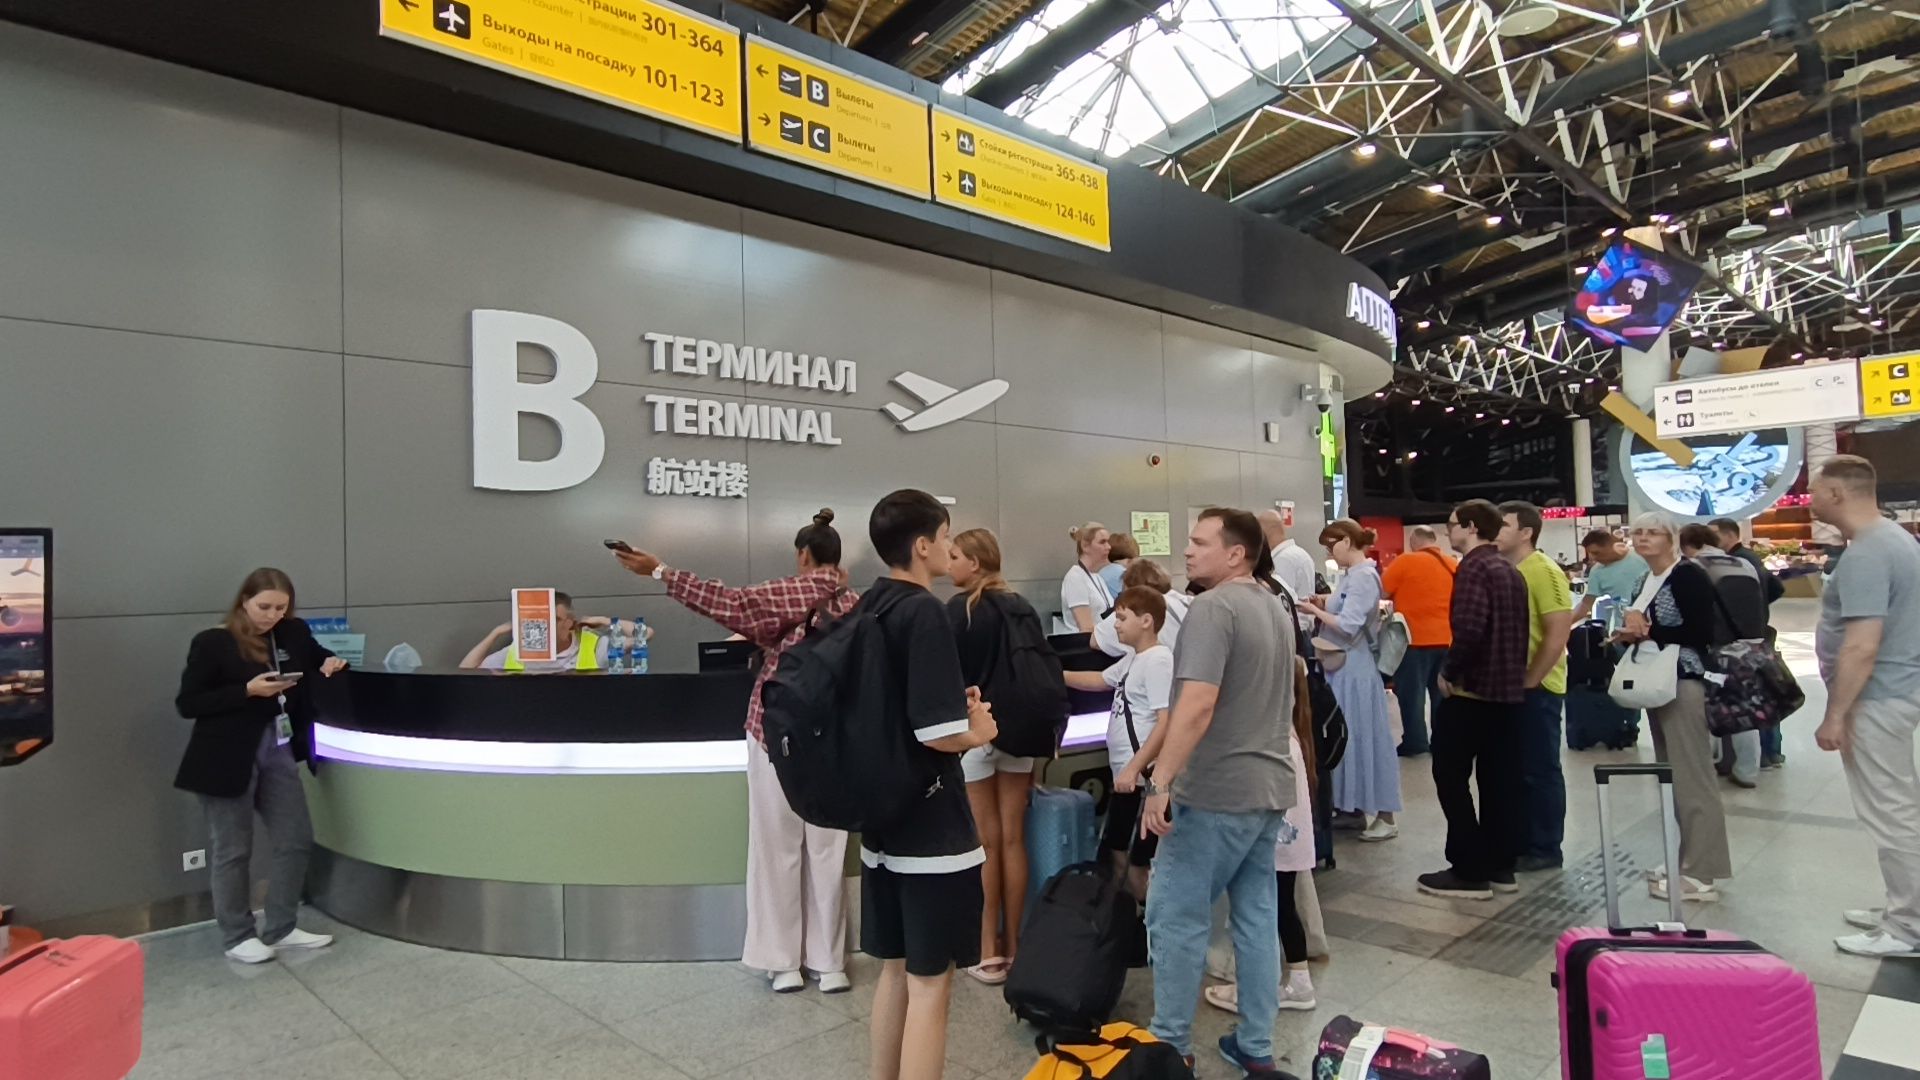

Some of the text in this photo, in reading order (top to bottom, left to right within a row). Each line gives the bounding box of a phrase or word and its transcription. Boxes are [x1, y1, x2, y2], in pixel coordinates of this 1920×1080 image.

[482, 36, 514, 55] Gates
[641, 12, 724, 57] 301-364
[482, 13, 550, 47] Выходы
[555, 40, 573, 54] на
[576, 48, 637, 77] посадку
[643, 65, 725, 107] 101-123
[836, 87, 874, 109] Вылеты
[837, 132, 876, 153] Вылеты
[979, 138, 1007, 155] Стойки
[1056, 163, 1099, 190] 365-438
[981, 178, 1013, 196] Выходы
[1013, 191, 1023, 200] на
[1023, 194, 1053, 211] посадку
[1056, 203, 1096, 227] 124-146
[643, 332, 857, 394] ТЕРМИНАЛ
[644, 394, 842, 446] TERMINAL
[647, 456, 749, 498] 航站楼
